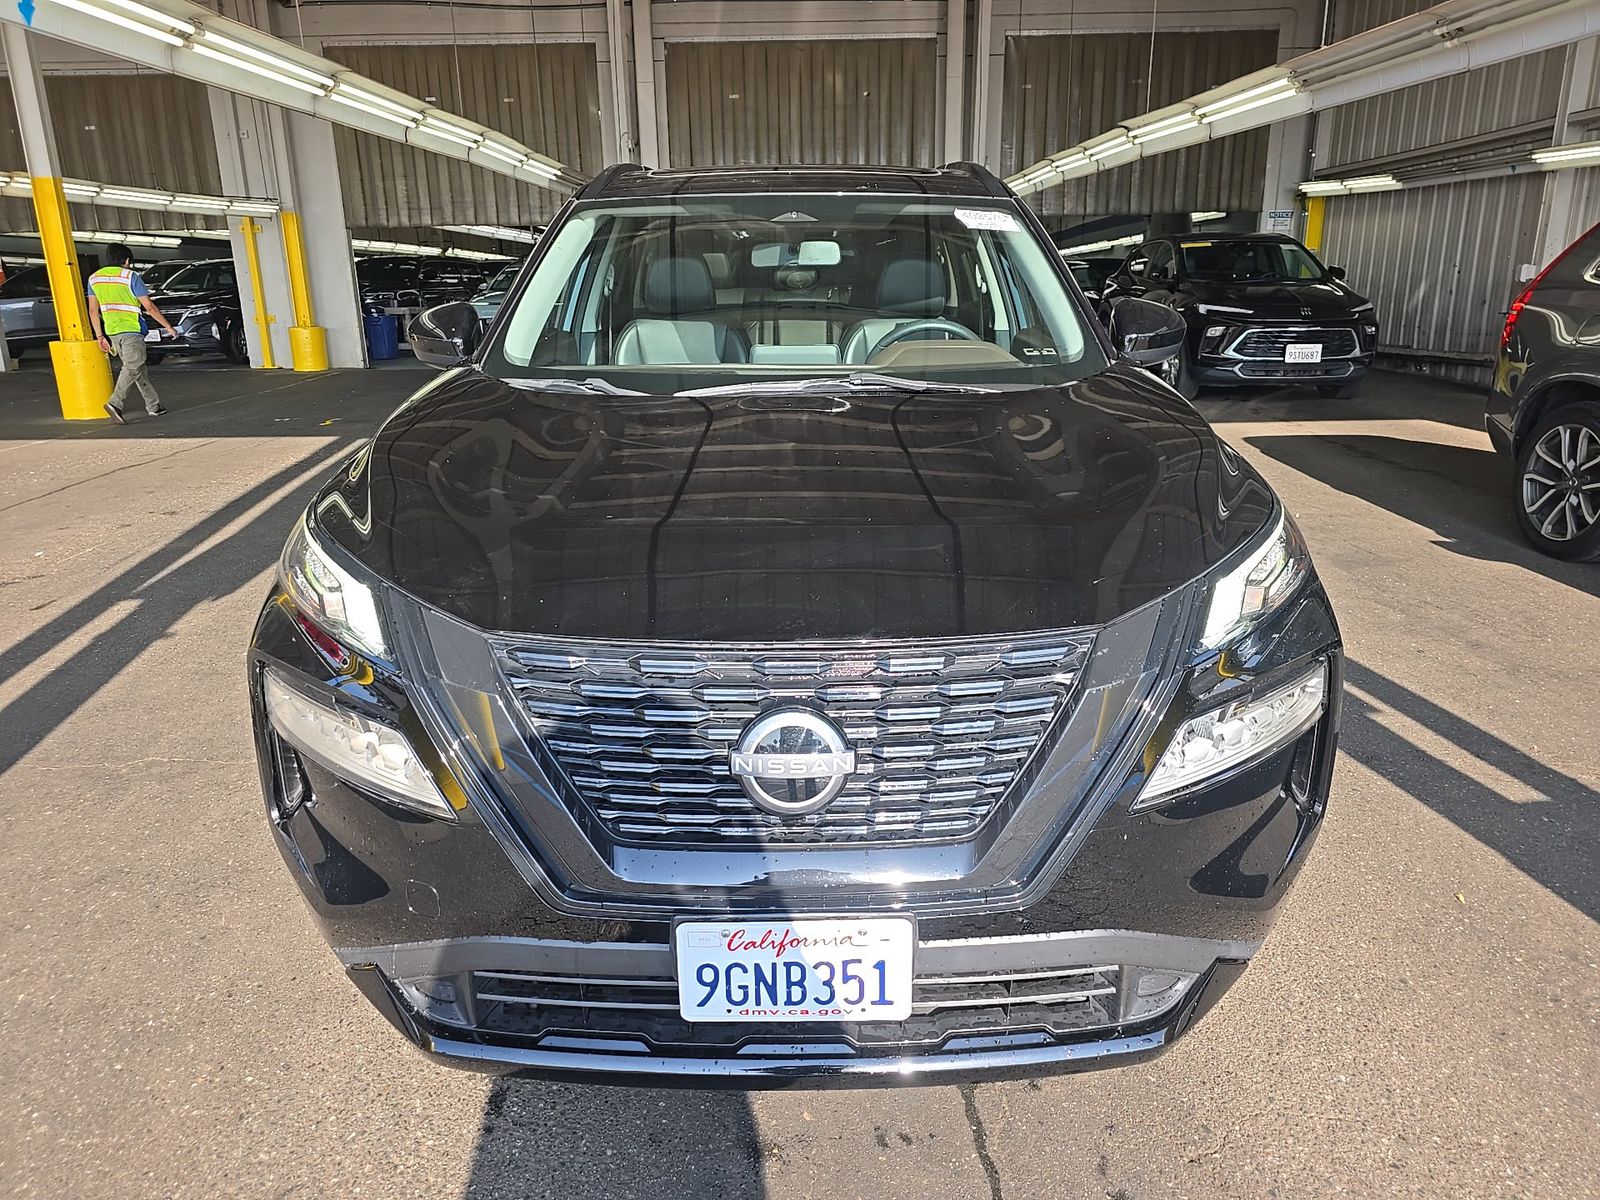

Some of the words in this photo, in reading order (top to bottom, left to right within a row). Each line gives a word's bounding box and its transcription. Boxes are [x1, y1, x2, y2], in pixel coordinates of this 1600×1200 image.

[735, 756, 850, 774] NISSAN
[727, 928, 869, 957] California
[696, 958, 894, 1007] 9GNB351
[738, 1007, 853, 1016] dmv.ca.gov
